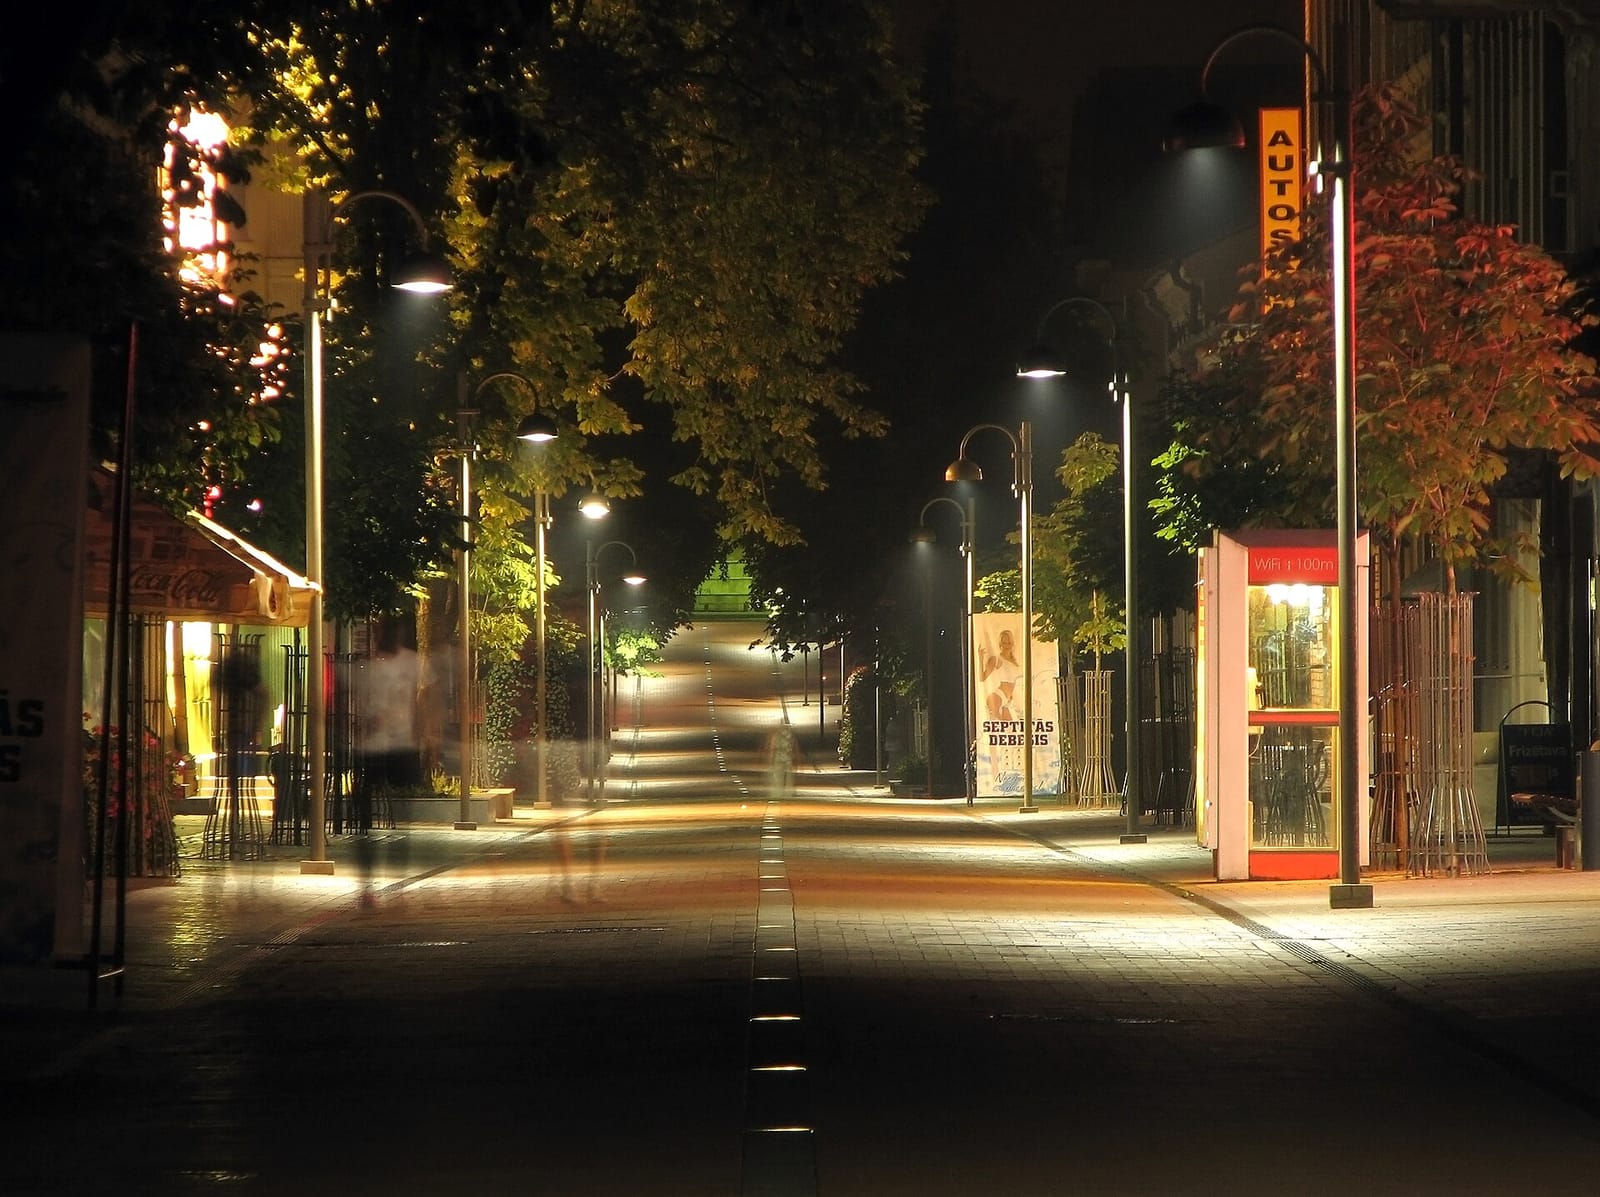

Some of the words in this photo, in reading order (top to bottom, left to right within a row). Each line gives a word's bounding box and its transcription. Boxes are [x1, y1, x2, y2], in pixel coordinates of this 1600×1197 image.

[1267, 129, 1295, 252] AUTOS
[1254, 557, 1281, 570] WiFi
[1298, 557, 1334, 570] 100m
